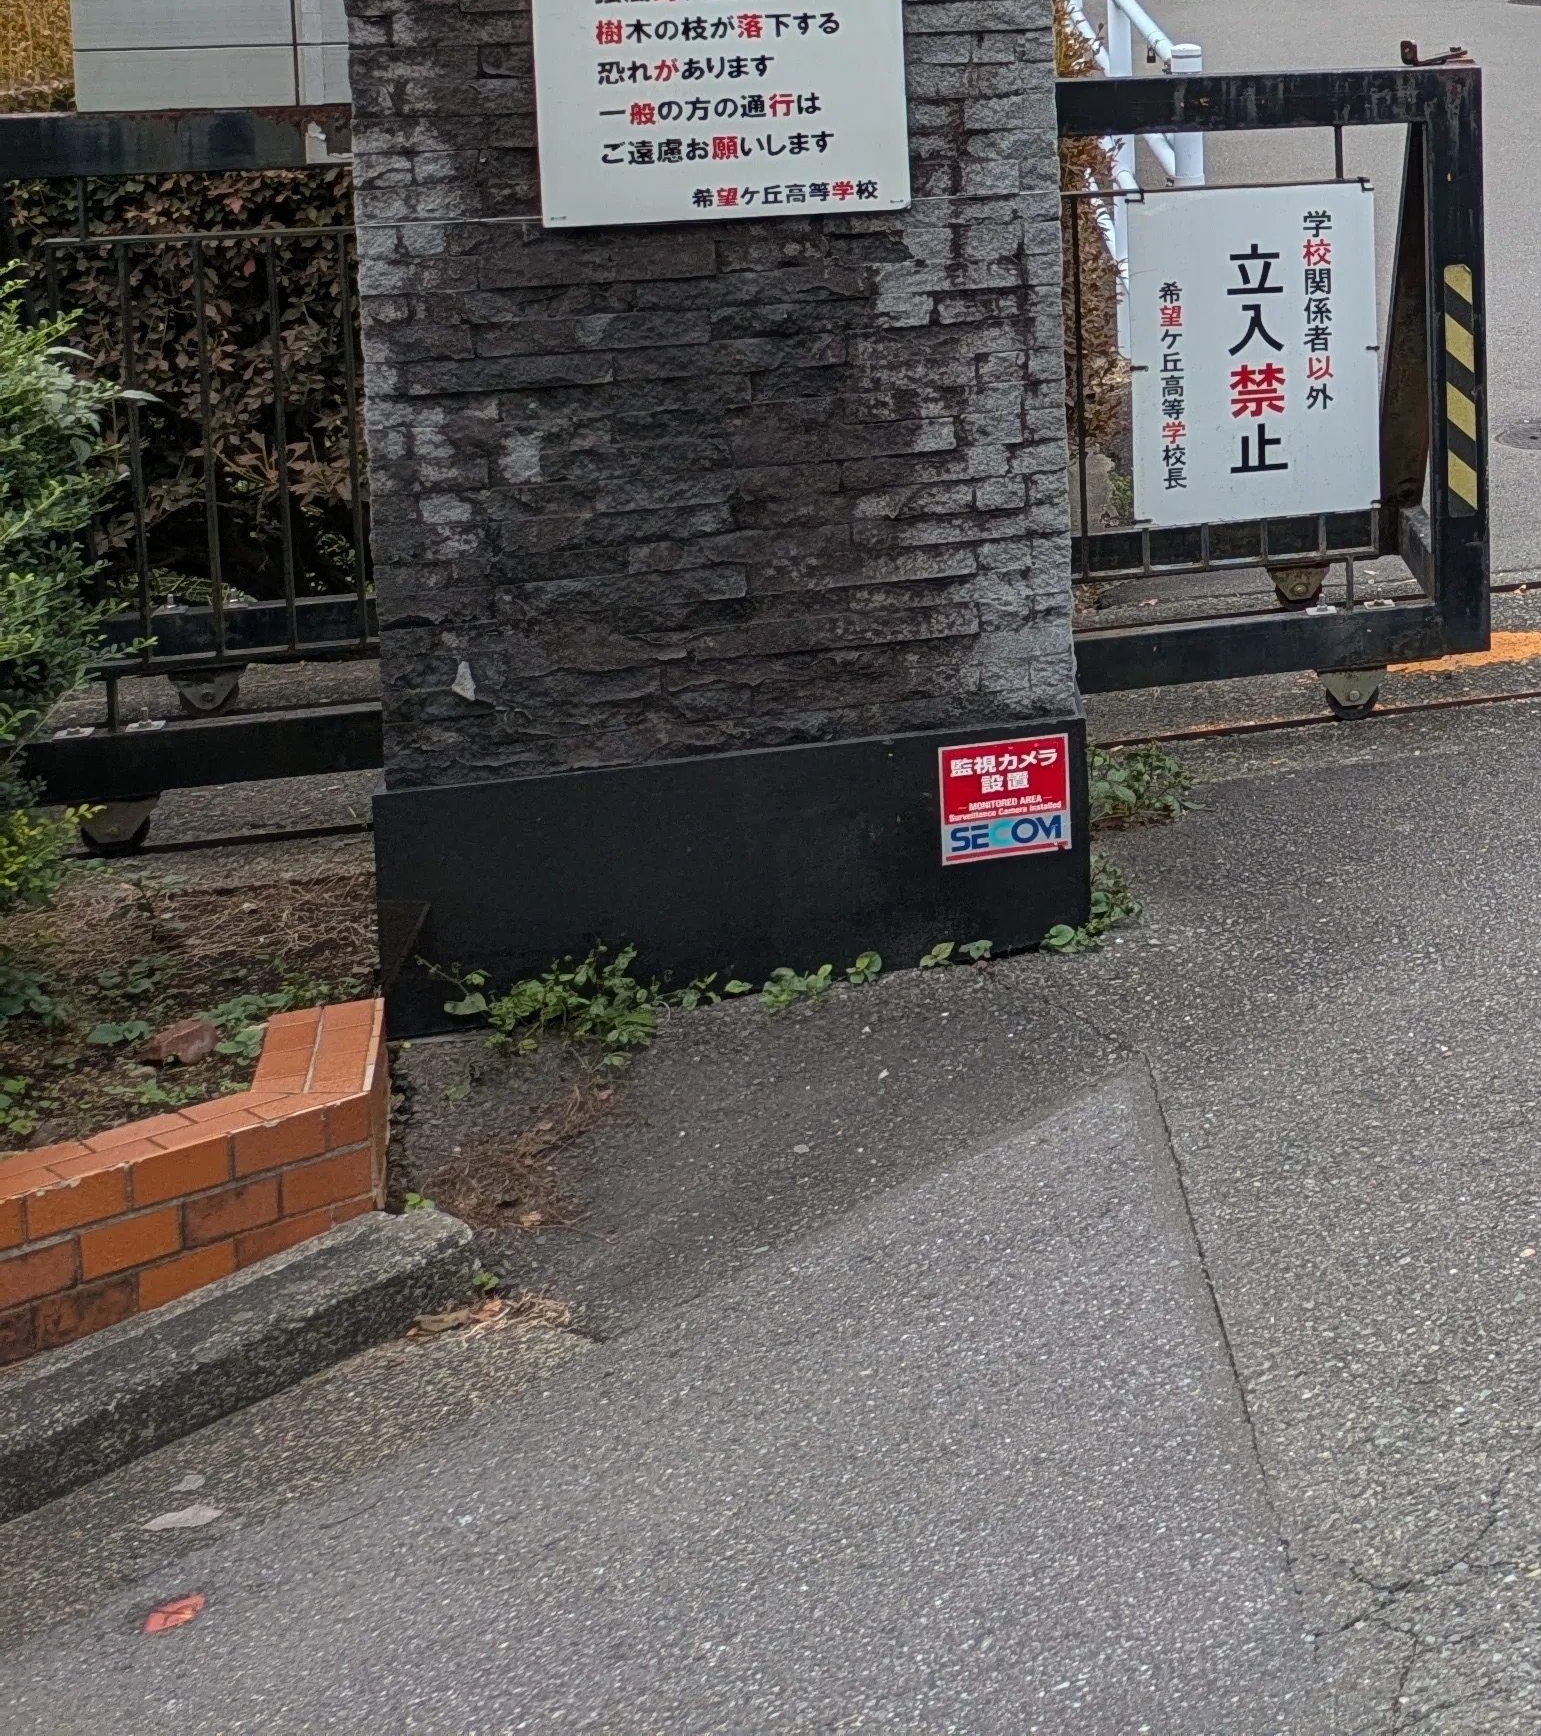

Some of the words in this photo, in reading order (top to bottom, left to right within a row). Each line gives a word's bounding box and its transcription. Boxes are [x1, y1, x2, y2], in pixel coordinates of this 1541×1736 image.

[596, 12, 841, 45] 樹木の枝が落下する
[598, 55, 775, 85] 恐れがあります
[599, 93, 822, 126] 一般の方の通行は
[601, 130, 835, 165] ご遠慮お願いします
[1303, 210, 1334, 410] 学校関係者以外
[1226, 244, 1289, 475] 立入禁止
[950, 748, 1058, 778] 監視カメラ
[981, 771, 1029, 794] 設置
[969, 797, 1018, 811] MONITORED
[1020, 794, 1042, 805] AREA
[951, 815, 1061, 852] SECOM
